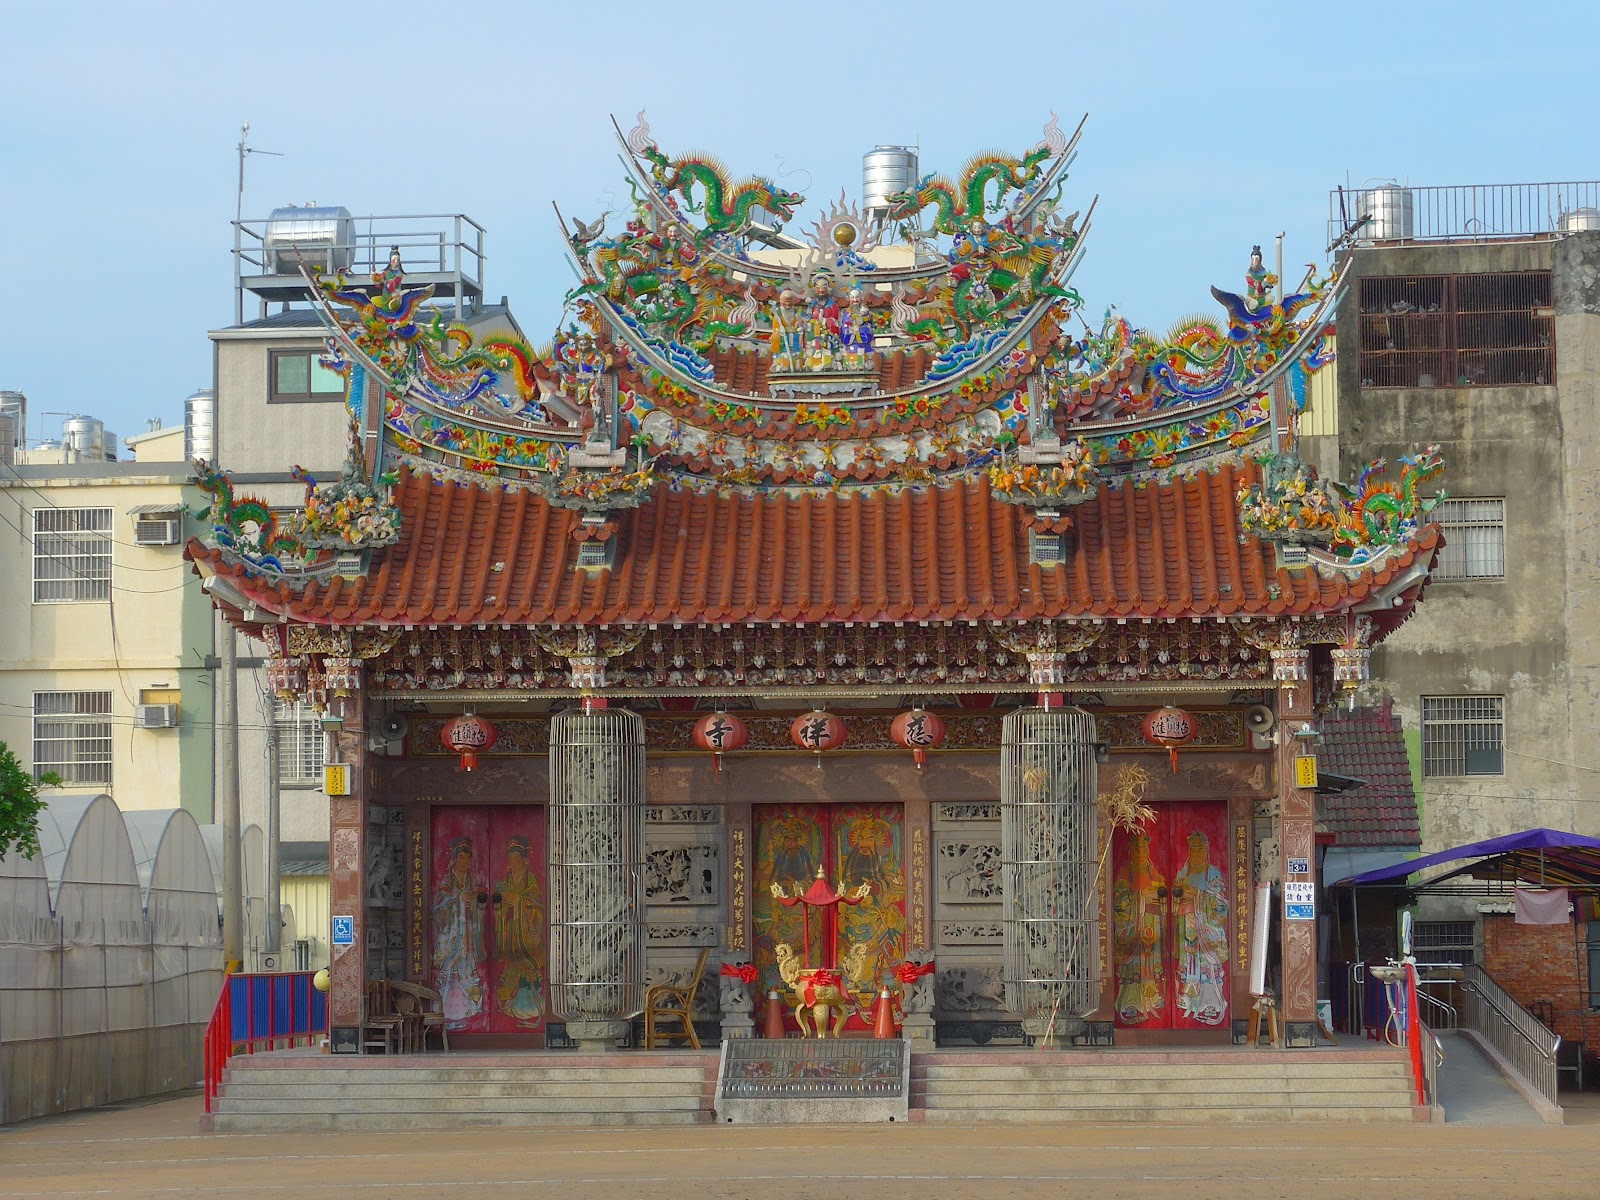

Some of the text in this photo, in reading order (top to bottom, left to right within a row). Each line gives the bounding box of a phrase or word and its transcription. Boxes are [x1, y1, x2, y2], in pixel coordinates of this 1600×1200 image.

[705, 717, 733, 748] 寺
[800, 717, 831, 747] 祥
[905, 715, 934, 747] 慈
